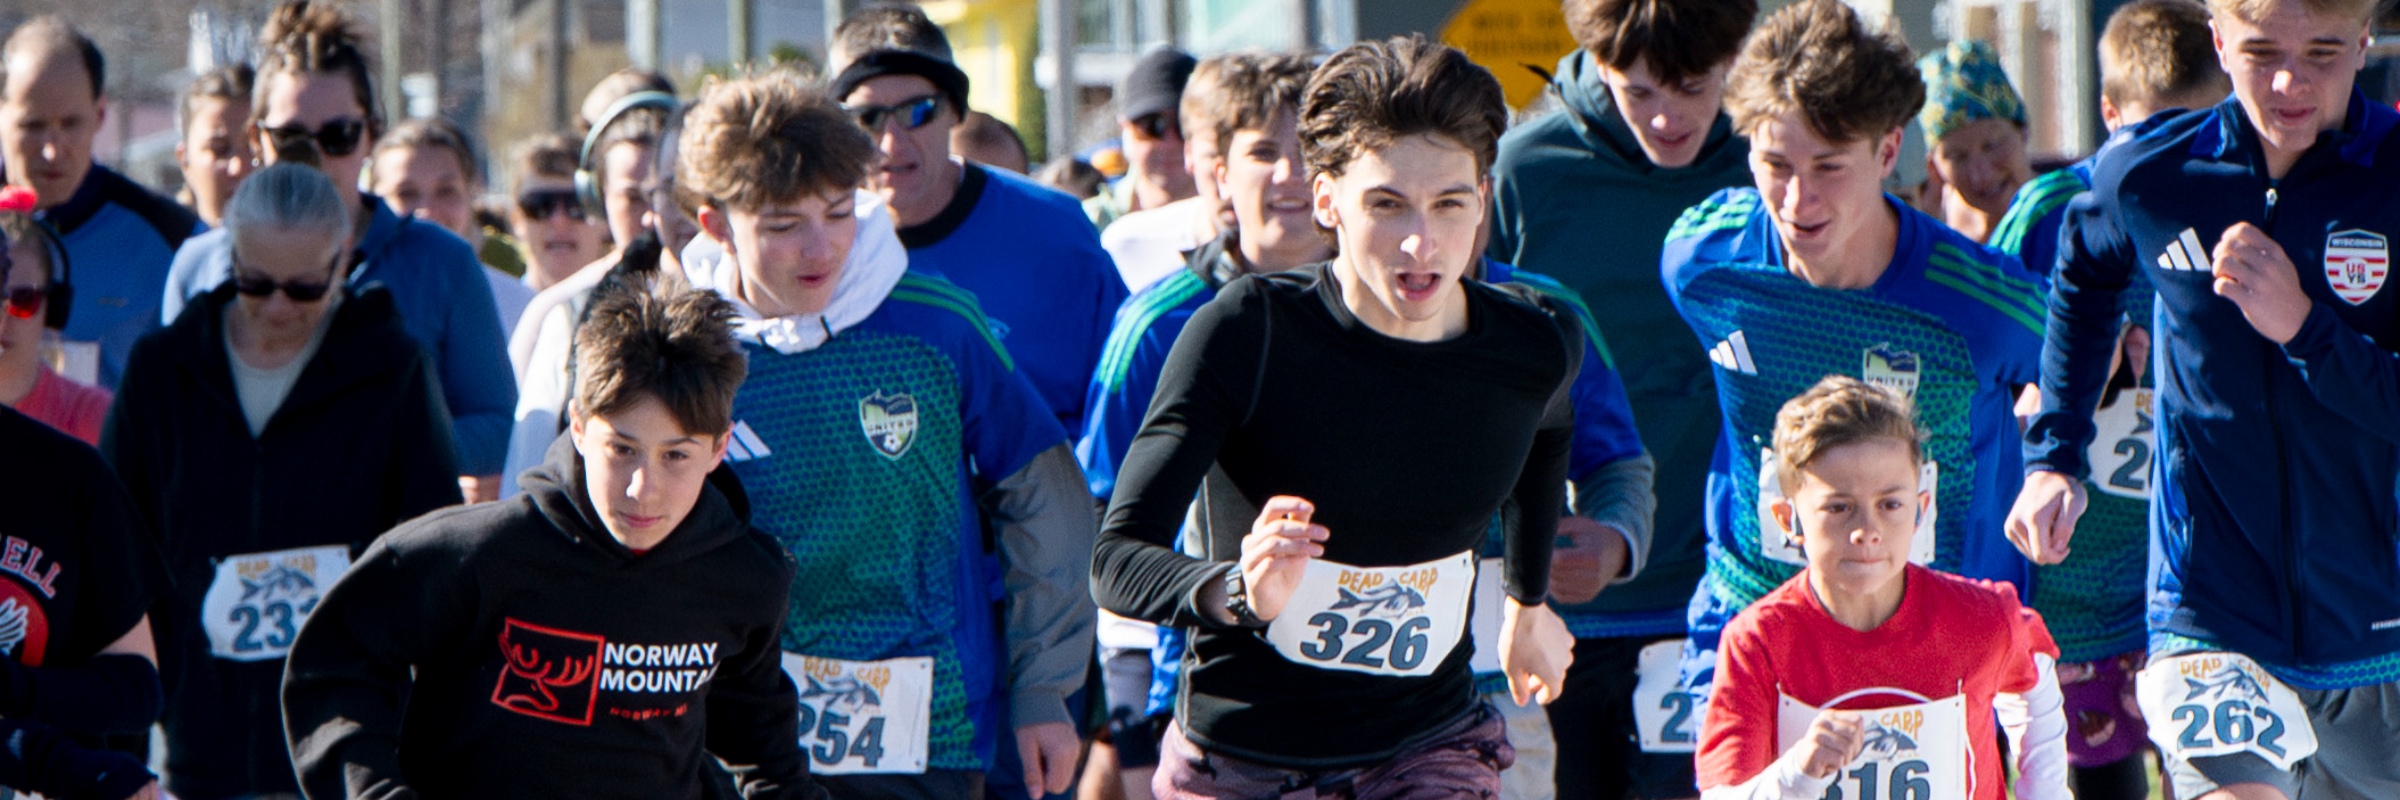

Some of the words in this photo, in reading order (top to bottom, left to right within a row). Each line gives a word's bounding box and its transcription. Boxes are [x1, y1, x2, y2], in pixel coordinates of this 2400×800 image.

[2109, 438, 2155, 491] 2
[0, 534, 62, 600] ELL
[1338, 569, 1384, 594] DEAD
[1399, 567, 1438, 599] CARP
[604, 641, 718, 666] NORWAY
[1300, 611, 1431, 671] 326
[2180, 656, 2222, 679] DEAD
[1881, 709, 1923, 741] CARP
[2172, 700, 2287, 760] 262
